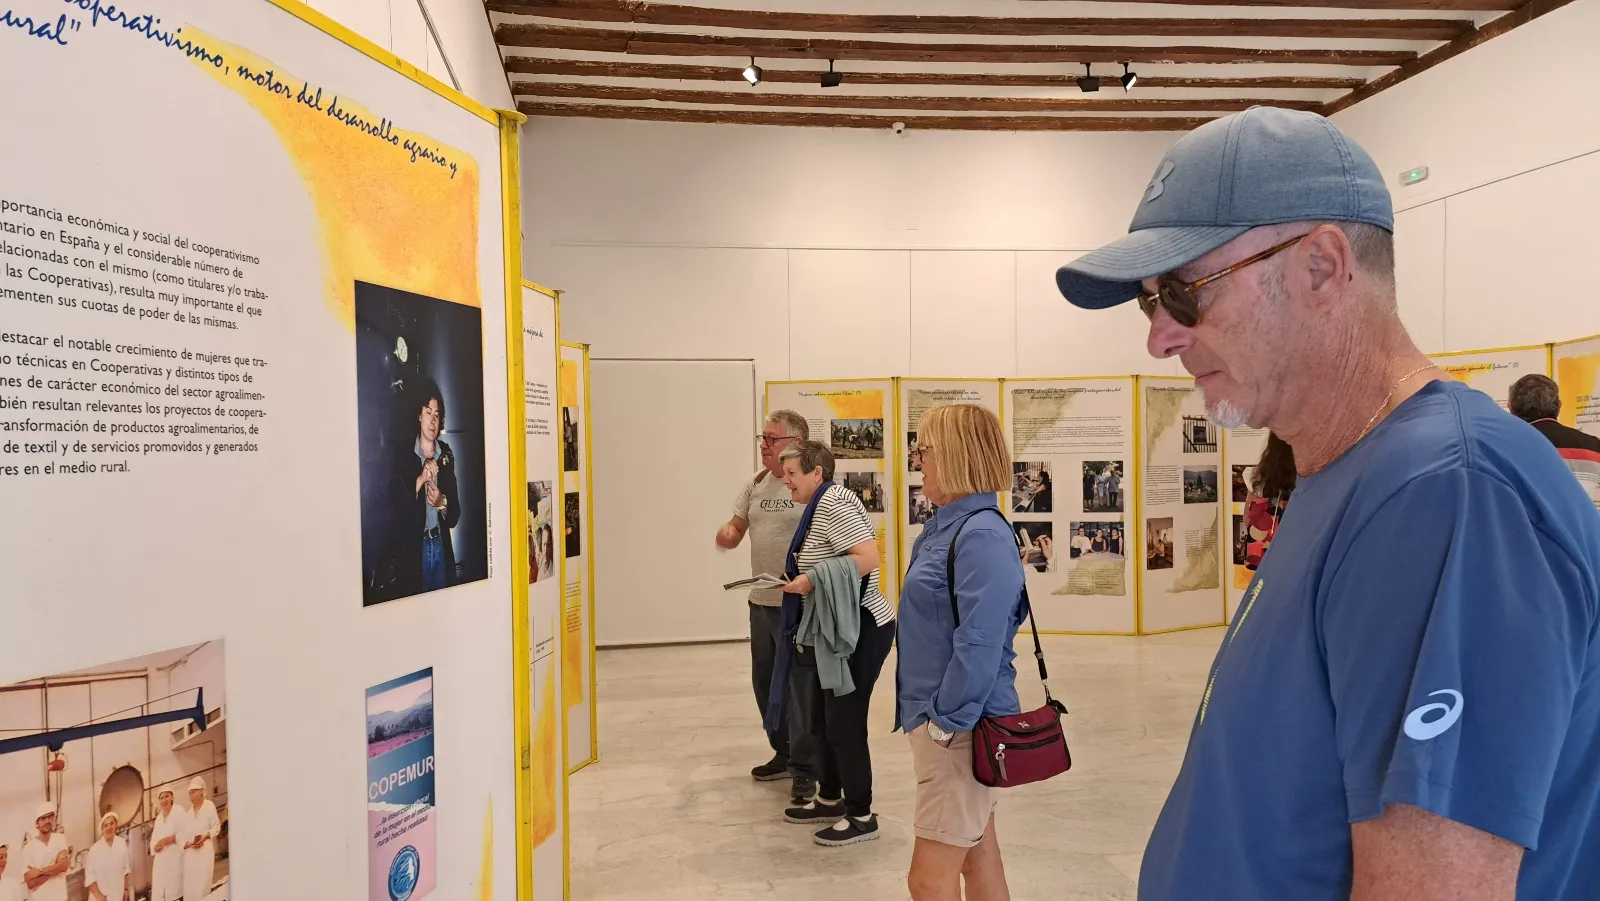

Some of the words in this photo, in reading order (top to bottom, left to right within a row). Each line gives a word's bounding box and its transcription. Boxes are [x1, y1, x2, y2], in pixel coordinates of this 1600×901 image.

[64, 0, 229, 76] operativismo,
[236, 64, 292, 98] motor
[297, 82, 322, 111] del
[327, 96, 399, 145] desarrollo
[404, 139, 446, 166] agrario
[450, 162, 458, 179] y
[40, 229, 54, 241] en
[60, 230, 100, 250] España
[104, 243, 110, 255] y
[114, 243, 123, 255] el
[128, 248, 191, 268] considerable
[195, 261, 230, 276] número
[233, 268, 244, 278] de
[68, 213, 129, 237] económica
[133, 229, 139, 241] y
[143, 230, 170, 246] social
[174, 237, 188, 250] del
[192, 243, 260, 264] cooperativismo
[6, 263, 22, 278] las
[28, 267, 116, 296] Cooperativas),
[120, 284, 155, 299] resulta
[158, 292, 180, 306] muy
[182, 294, 234, 312] importante
[237, 302, 244, 314] el
[247, 306, 262, 318] que
[74, 257, 94, 270] con
[100, 259, 108, 272] el
[113, 262, 148, 278] mismo
[152, 269, 184, 285] (como
[188, 276, 225, 292] titulares
[228, 283, 242, 296] y/o
[244, 286, 268, 300] traba-
[58, 296, 77, 308] sus
[82, 300, 118, 314] cuotas
[122, 304, 136, 316] de
[139, 307, 170, 321] poder
[174, 310, 186, 322] de
[188, 312, 201, 324] las
[204, 316, 239, 330] mismas.
[0, 330, 48, 346] estacar
[54, 336, 64, 348] el
[68, 338, 112, 352] notable
[116, 343, 177, 358] crecimiento
[180, 348, 192, 360] de
[196, 352, 232, 366] mujeres
[234, 356, 250, 368] que
[252, 358, 268, 368] tra-
[16, 353, 68, 369] técnicas
[72, 360, 86, 370] en
[90, 358, 162, 377] Cooperativas
[166, 368, 172, 380] y
[176, 366, 215, 380] distintos
[218, 370, 240, 384] tipos
[242, 372, 253, 383] de
[28, 375, 42, 388] de
[48, 378, 97, 392] carácter
[101, 382, 160, 396] económico
[164, 384, 180, 396] del
[182, 388, 212, 398] sector
[216, 388, 266, 401] agroalimen-
[33, 398, 82, 412] resultan
[86, 400, 142, 414] relevantes
[146, 402, 160, 414] los
[164, 404, 212, 417] proyectos
[214, 405, 226, 416] de
[228, 408, 266, 418] coopera-
[93, 420, 107, 432] de
[110, 421, 165, 435] productos
[168, 422, 246, 437] agroalimentarios,
[248, 424, 259, 434] de
[3, 440, 20, 454] de
[24, 440, 57, 454] textil
[62, 443, 68, 456] y
[72, 440, 87, 452] de
[92, 440, 140, 453] servicios
[144, 440, 202, 457] promovidos
[205, 442, 212, 454] y
[214, 440, 258, 456] generados
[24, 463, 39, 476] en
[44, 461, 54, 475] el
[60, 460, 96, 474] medio
[100, 460, 130, 473] rural.
[760, 499, 794, 508] GUESS
[368, 756, 434, 800] COPEMUR
